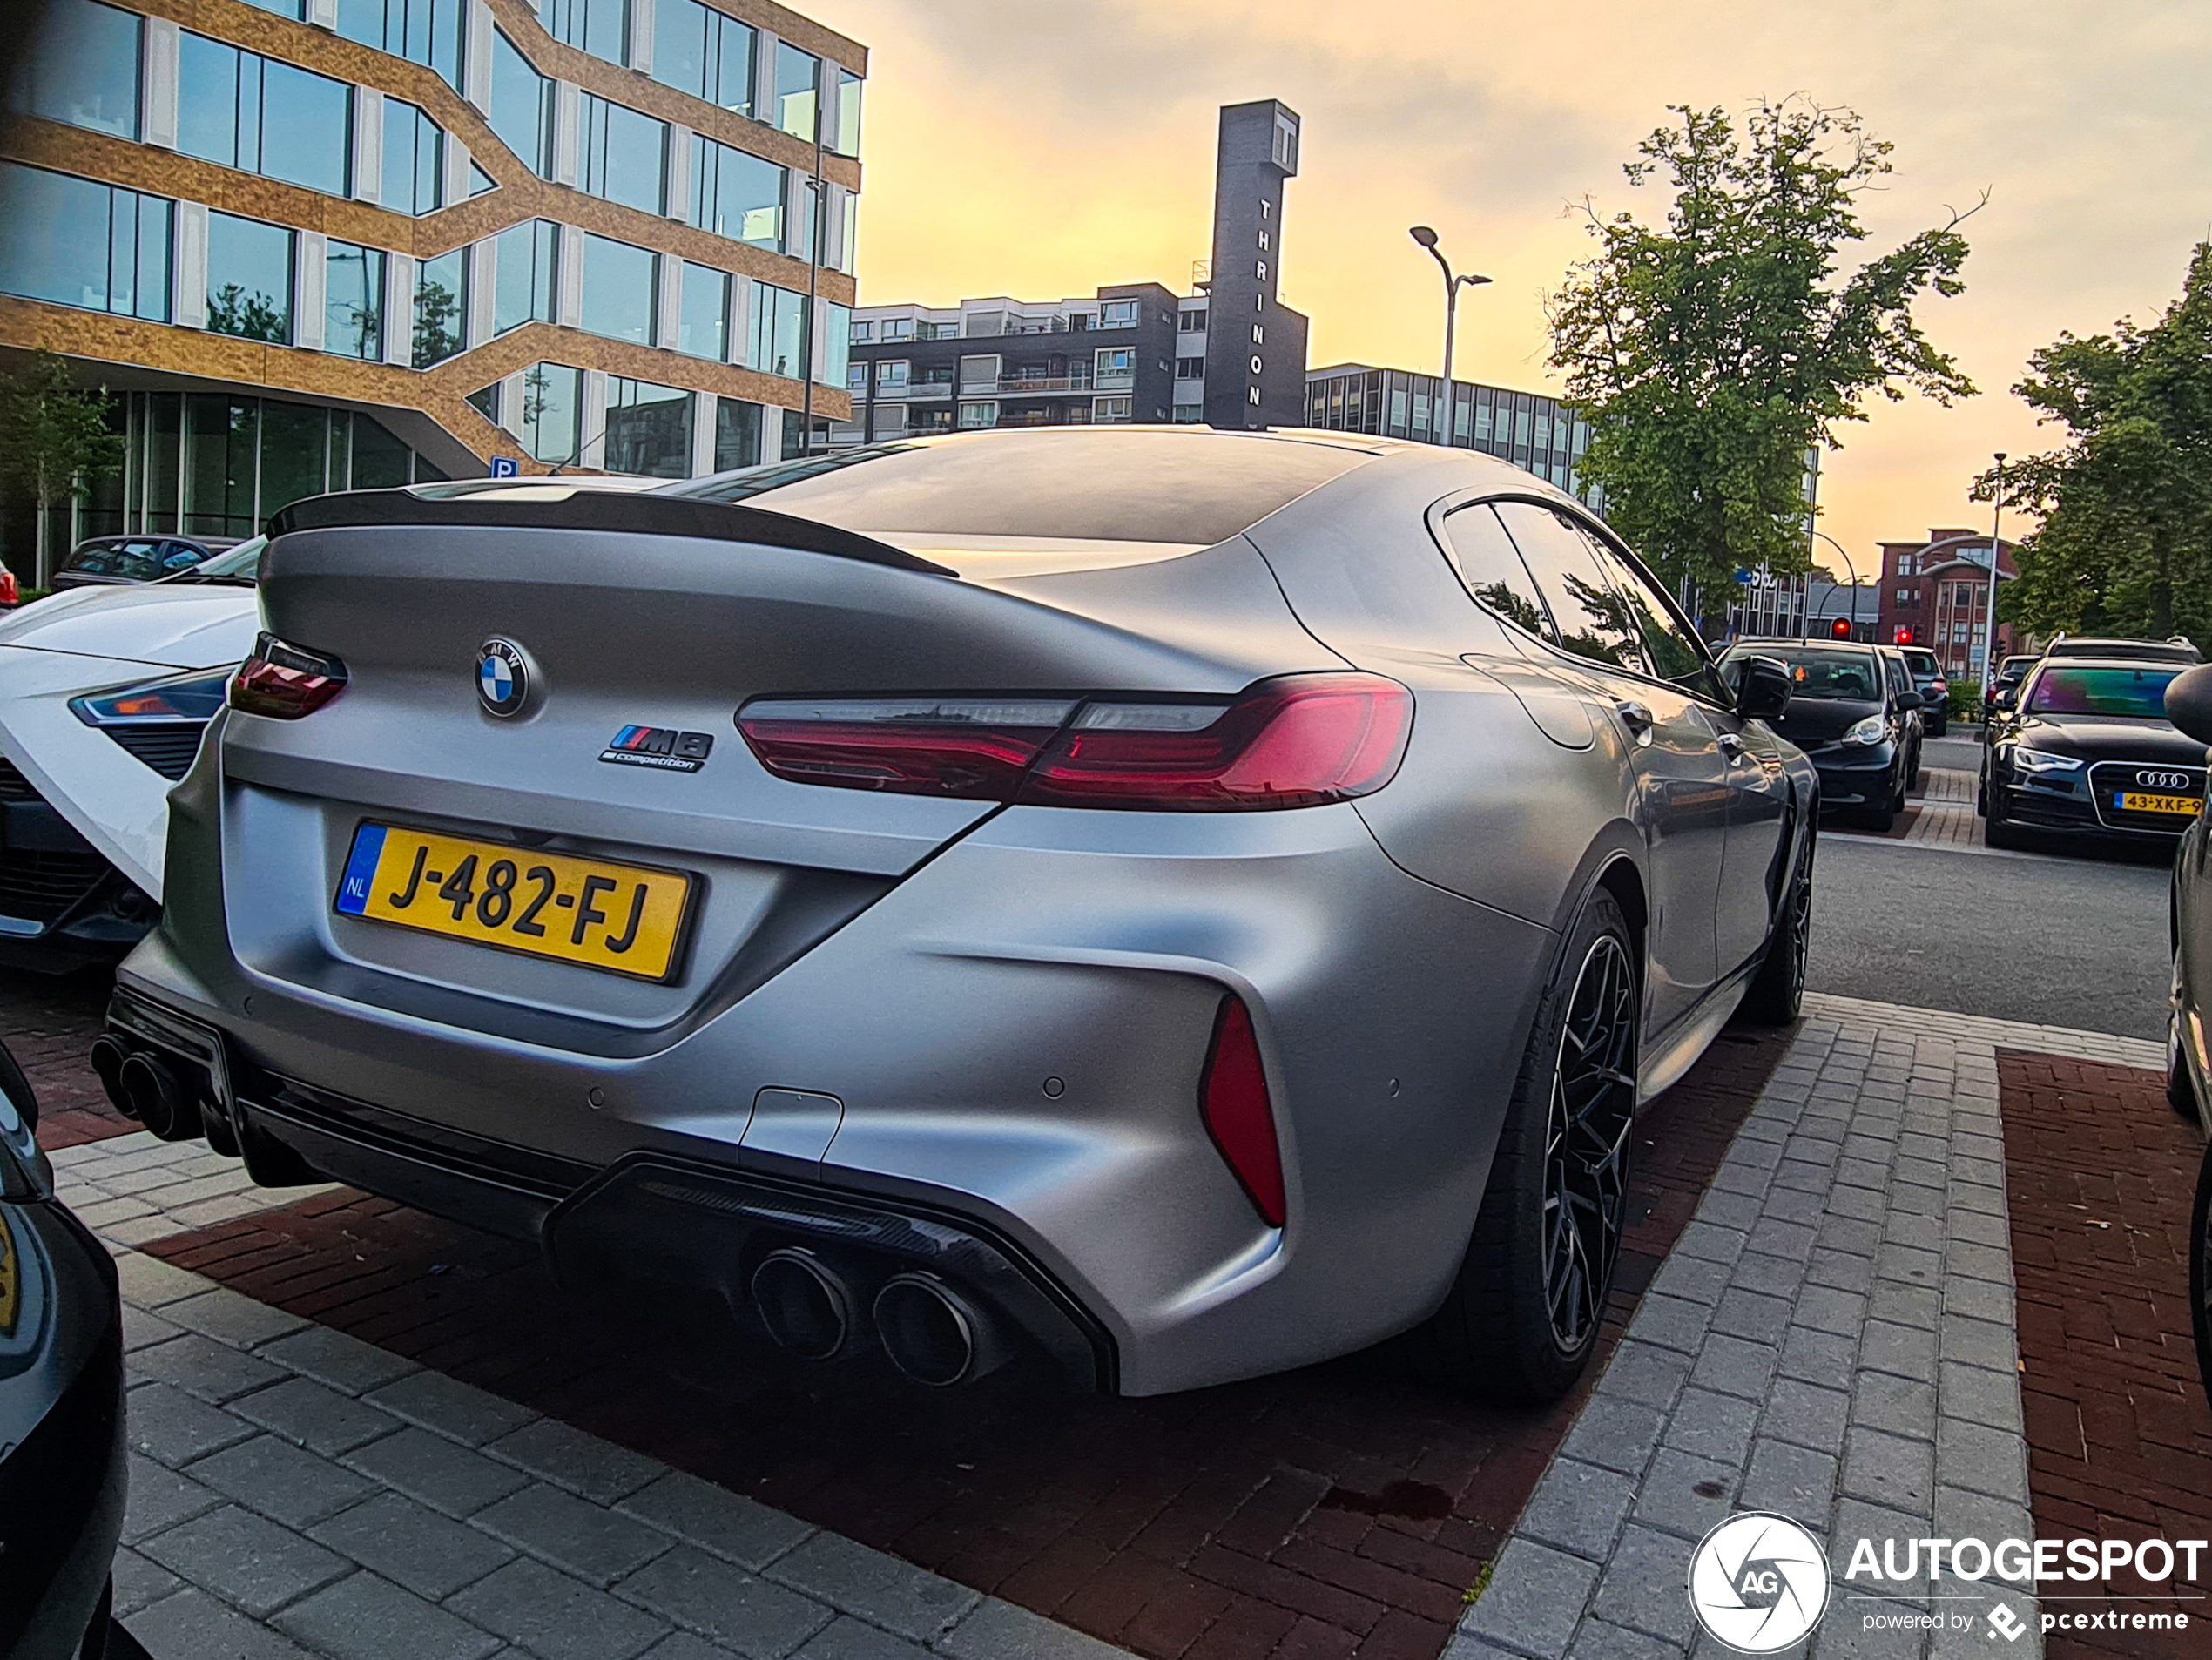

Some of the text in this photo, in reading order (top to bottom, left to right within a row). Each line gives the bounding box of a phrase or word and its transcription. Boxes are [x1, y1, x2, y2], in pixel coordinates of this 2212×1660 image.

[1248, 199, 1271, 407] THRINON
[497, 461, 512, 479] P
[476, 643, 520, 669] BMW
[620, 725, 715, 759] M8
[615, 752, 696, 770] competition
[2127, 794, 2202, 813] 43-XKF-9
[347, 876, 366, 899] NL
[388, 846, 649, 954] J-482-FJ
